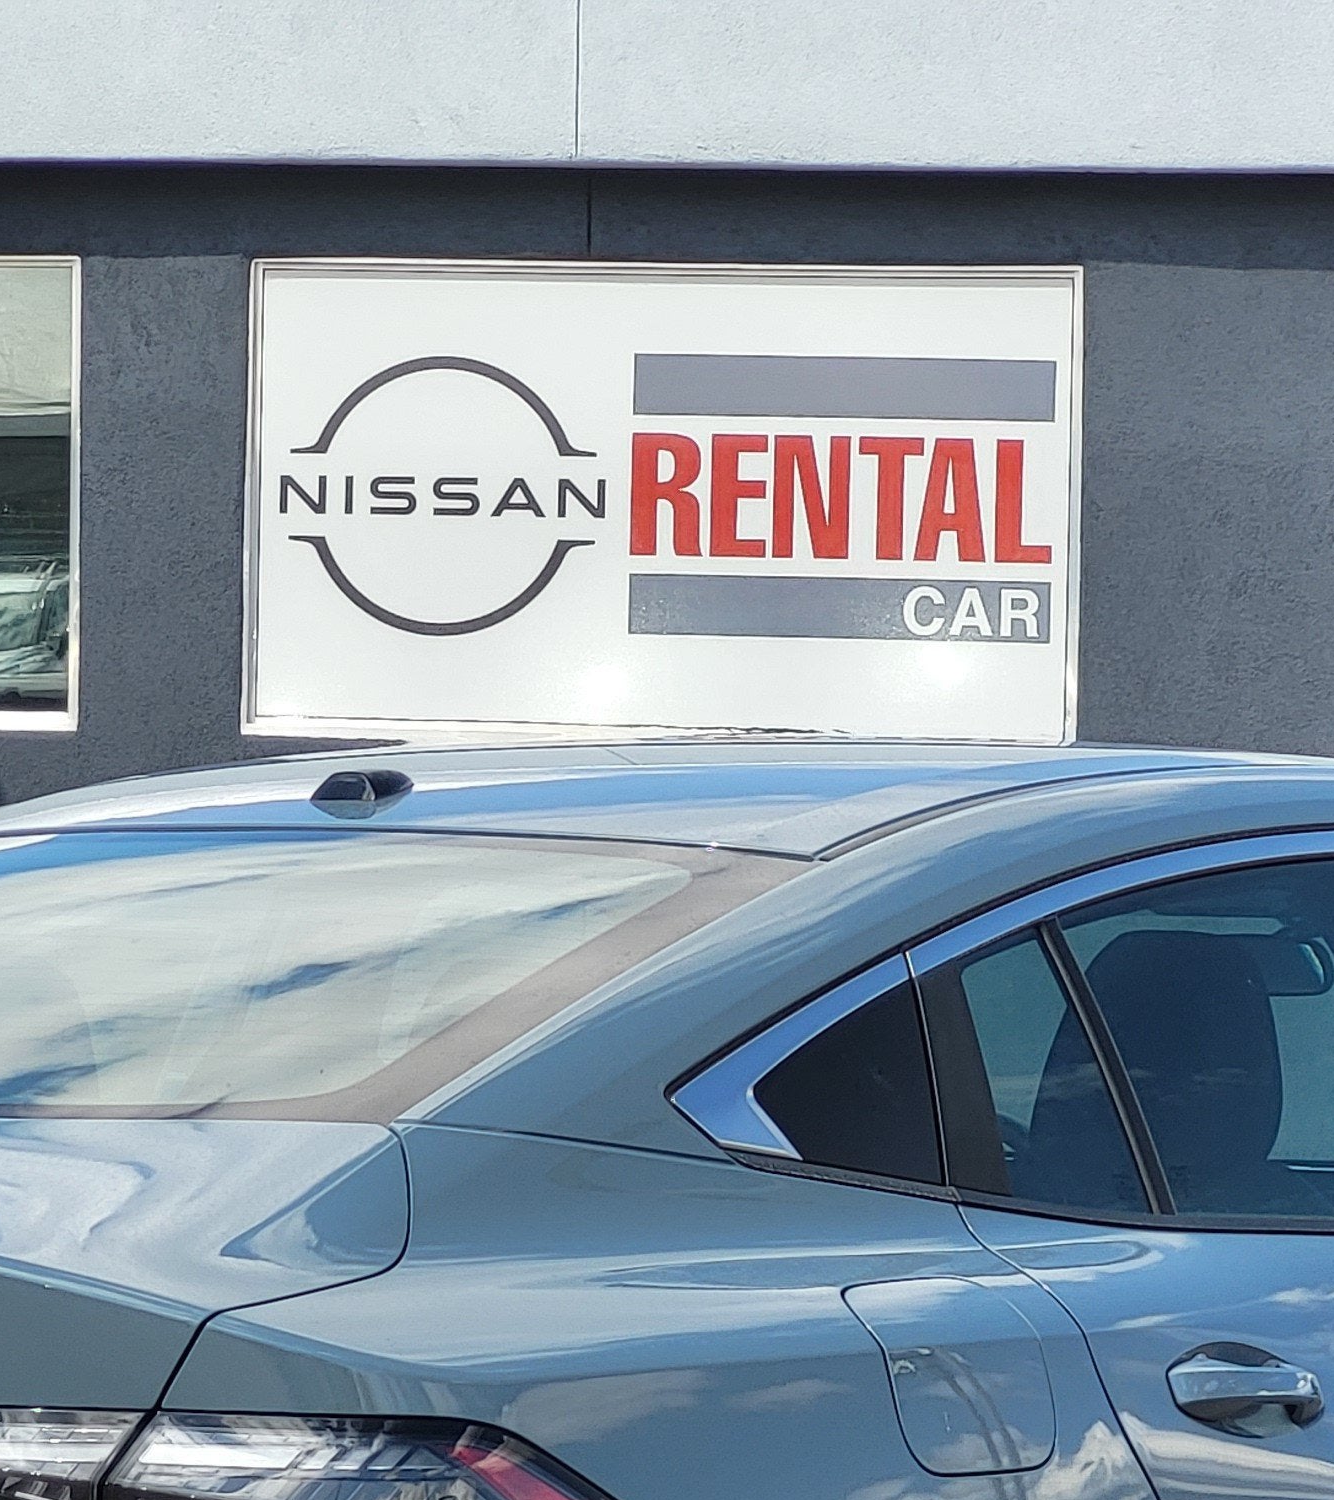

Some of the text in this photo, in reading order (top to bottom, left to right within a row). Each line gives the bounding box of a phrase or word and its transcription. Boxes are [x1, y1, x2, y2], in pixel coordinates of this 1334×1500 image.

[279, 474, 607, 519] NISSAN
[628, 432, 1052, 564] RENTAL
[902, 586, 1042, 639] CAR
